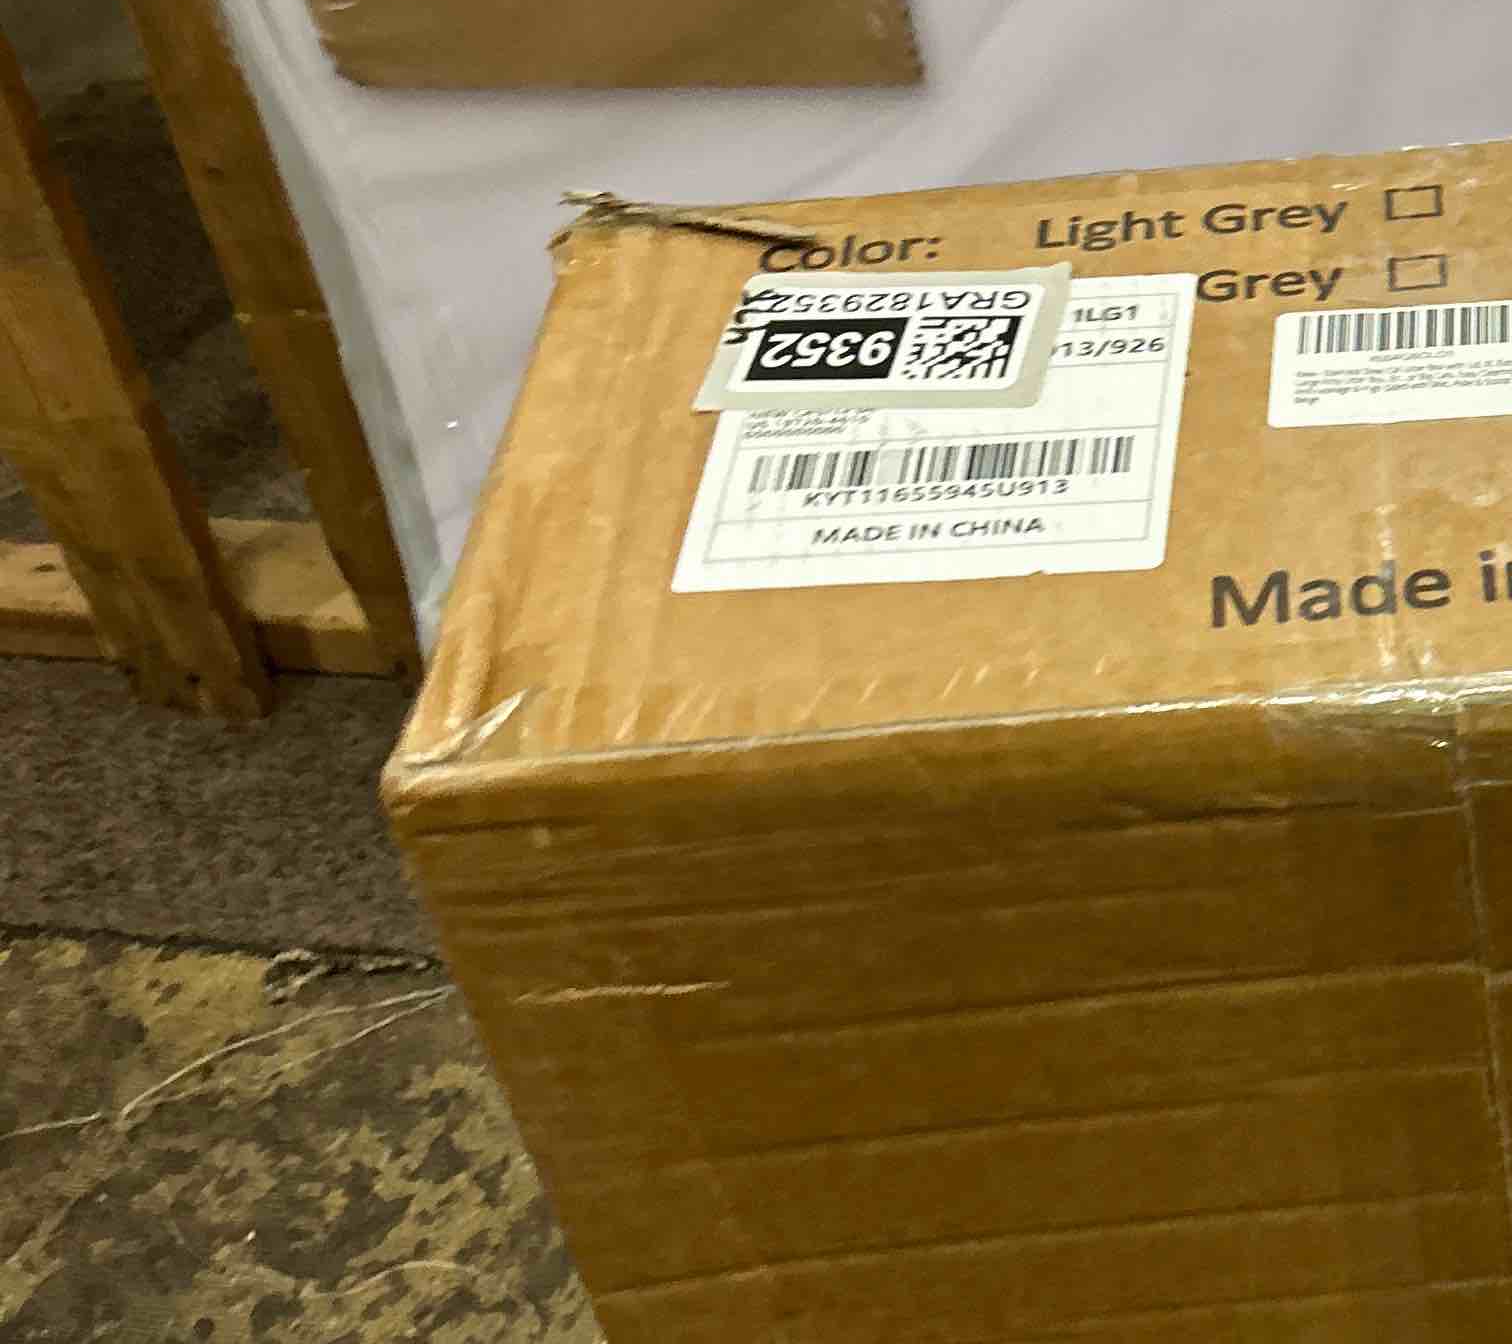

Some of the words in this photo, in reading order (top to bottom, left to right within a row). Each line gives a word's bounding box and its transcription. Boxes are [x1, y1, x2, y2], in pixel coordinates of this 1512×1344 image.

[1034, 209, 1184, 252] Light
[1201, 201, 1349, 235] Grey
[759, 233, 942, 273] Color:
[1197, 267, 1345, 303] Grey
[758, 329, 897, 369] 9352
[1050, 337, 1166, 358] 13/926
[811, 524, 904, 545] MADE
[907, 521, 942, 541] IN
[950, 517, 1046, 539] CHINA
[1210, 558, 1452, 628] Made
